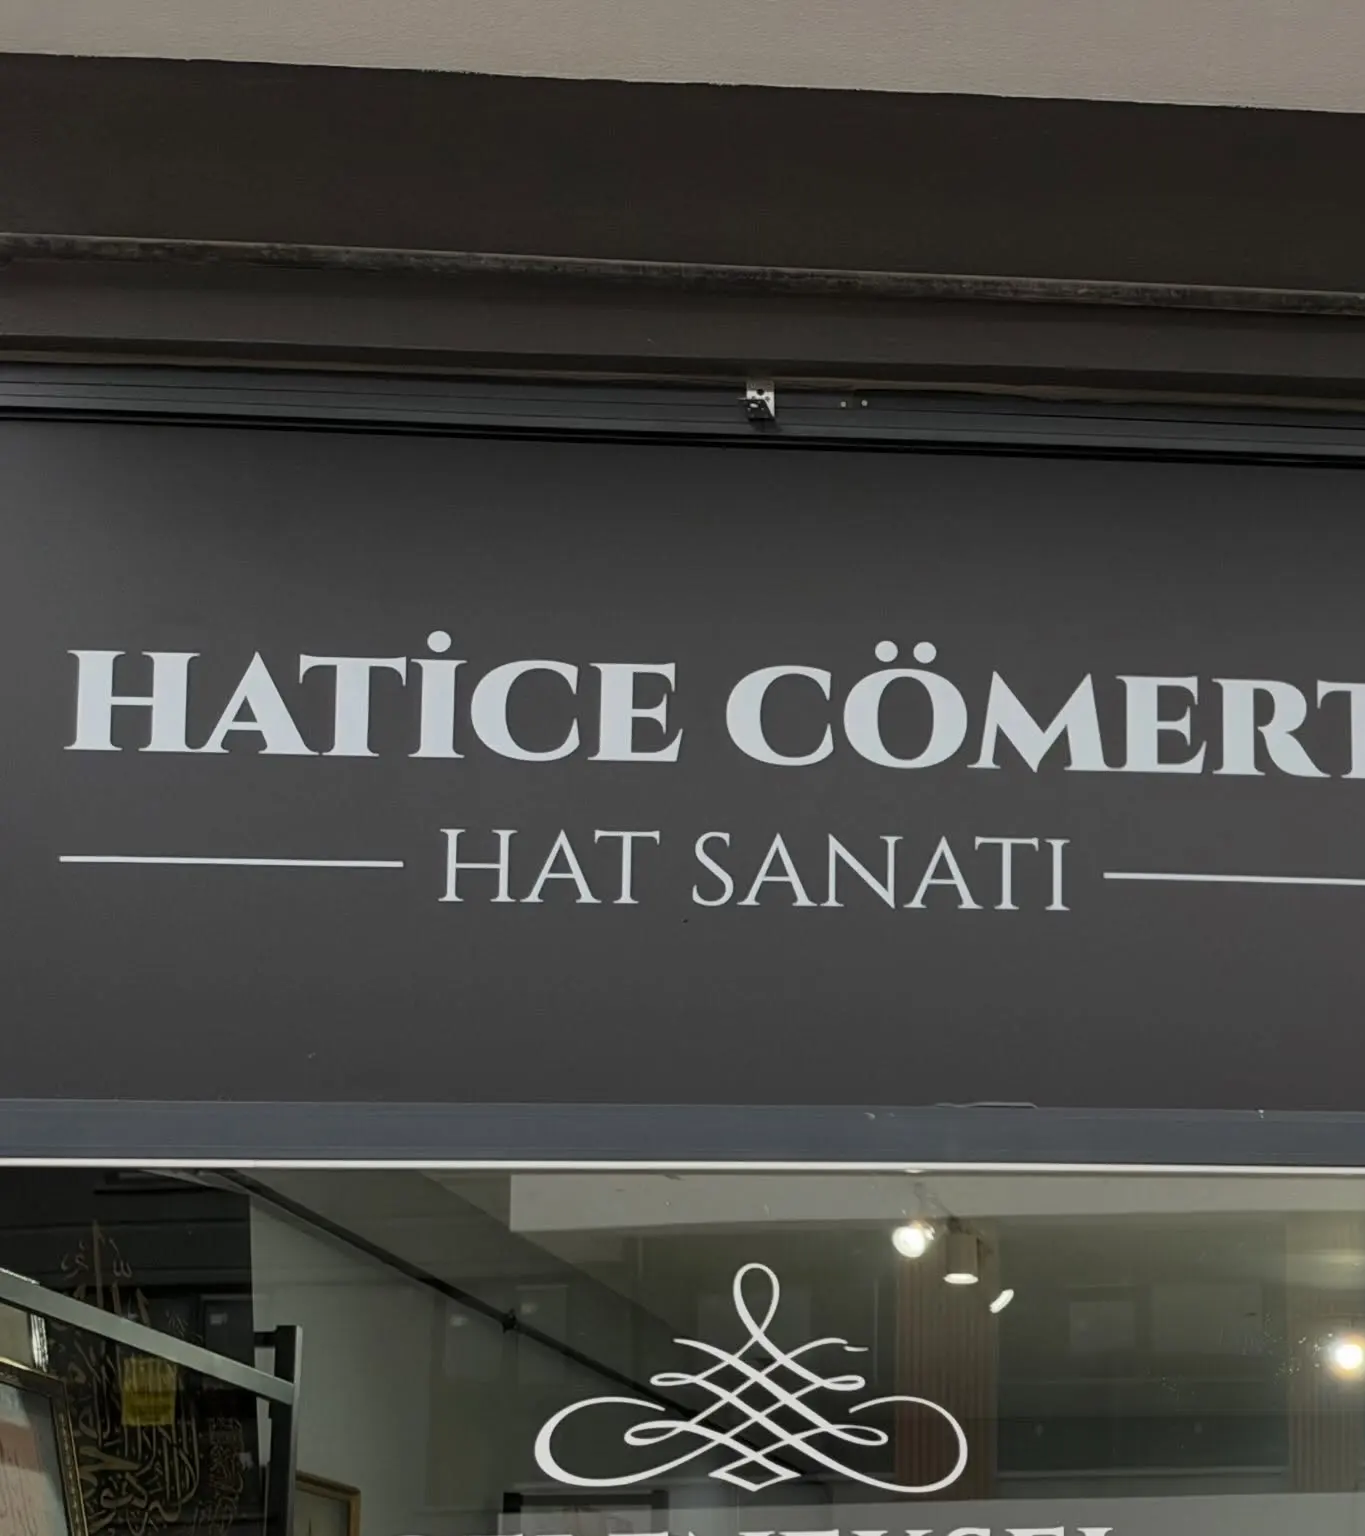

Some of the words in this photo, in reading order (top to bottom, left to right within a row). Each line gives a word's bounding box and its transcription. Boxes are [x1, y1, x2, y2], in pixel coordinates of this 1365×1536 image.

[62, 630, 684, 762] HATİCE
[437, 828, 660, 904] HAT
[691, 831, 1071, 911] SANATI
